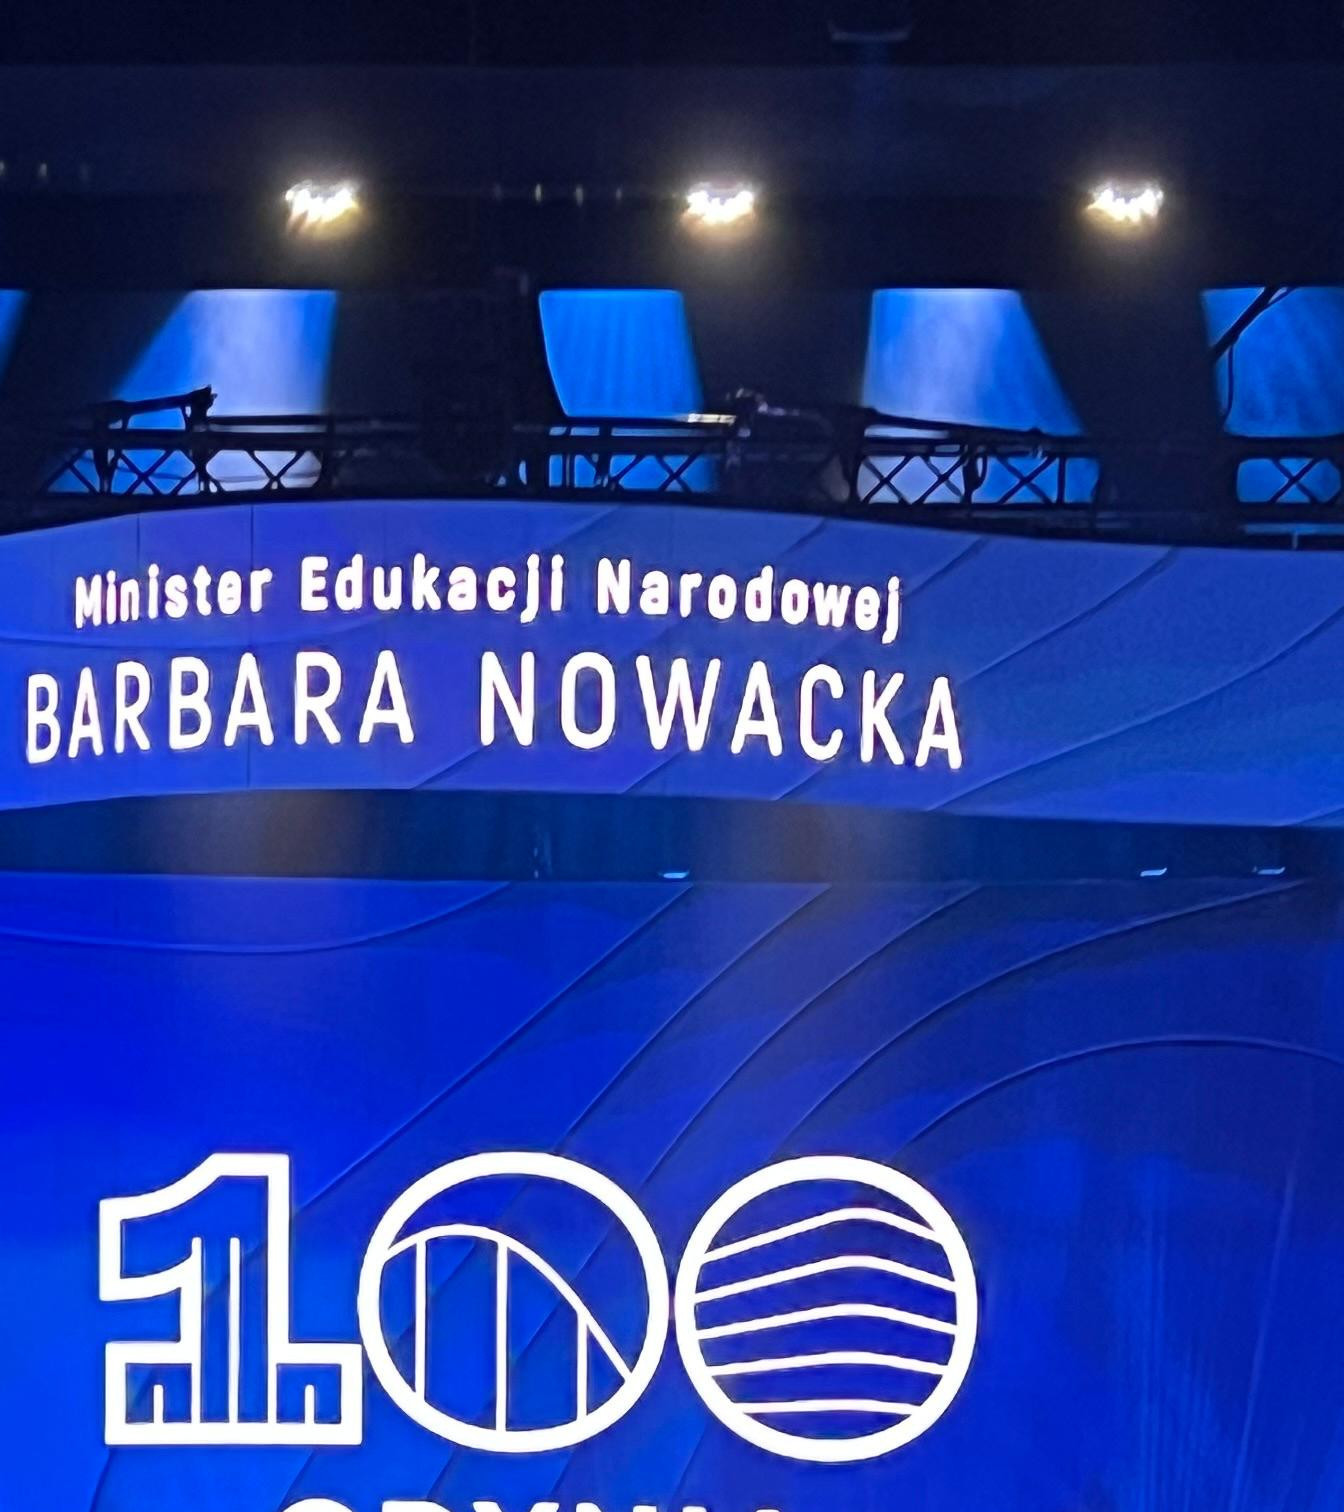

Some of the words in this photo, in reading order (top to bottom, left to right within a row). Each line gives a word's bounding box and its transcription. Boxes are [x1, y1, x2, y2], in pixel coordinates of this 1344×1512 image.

[75, 563, 273, 629] Minister
[300, 552, 564, 624] Edukacji
[597, 557, 900, 645] Narodowej
[25, 649, 415, 764] BARBARA
[480, 651, 963, 770] NOWACKA
[98, 1151, 978, 1463] 100
